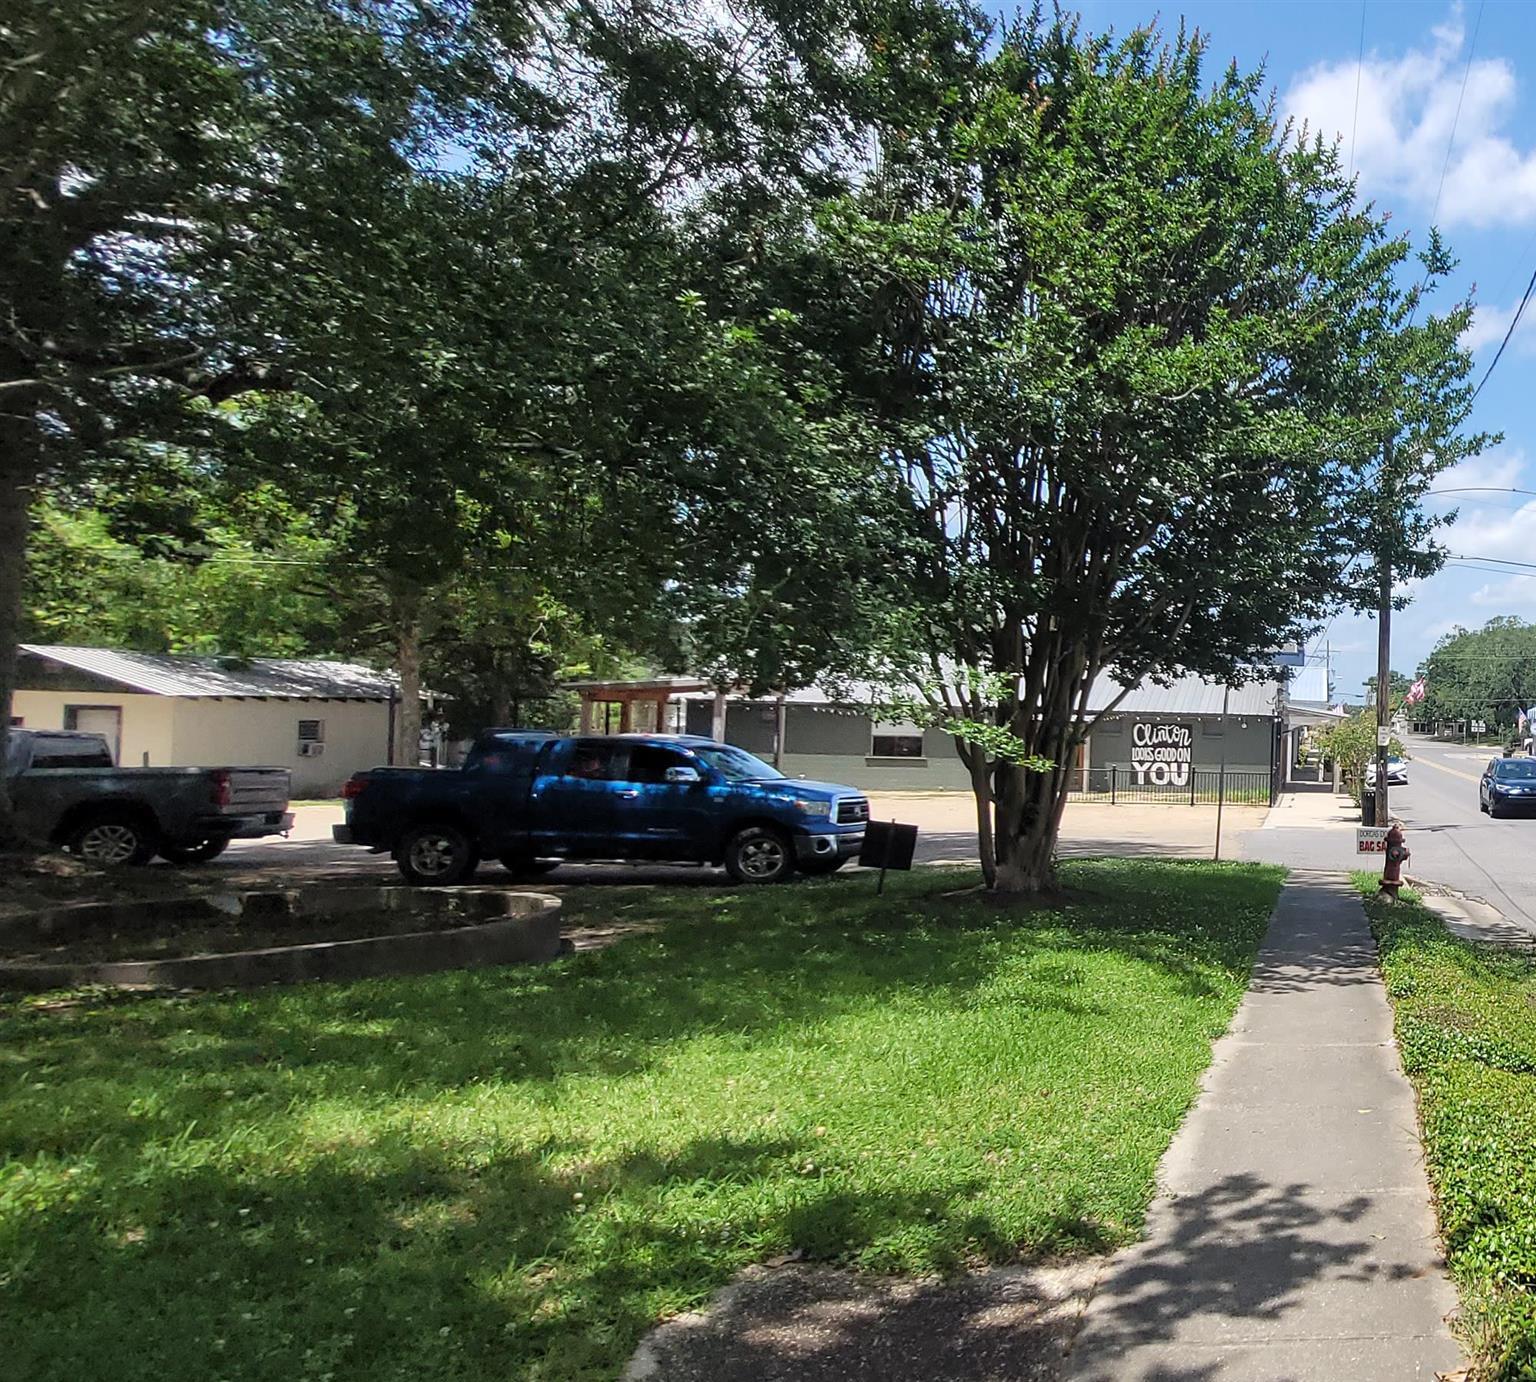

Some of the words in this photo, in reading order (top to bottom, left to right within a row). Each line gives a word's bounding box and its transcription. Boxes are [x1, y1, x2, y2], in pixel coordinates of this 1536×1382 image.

[1133, 723, 1192, 747] Clinton
[1131, 747, 1154, 761] LOOKS
[1154, 747, 1177, 762] GOOD
[1177, 747, 1191, 763] ON
[1131, 761, 1189, 786] YOU
[1359, 840, 1375, 852] BAG
[1376, 840, 1388, 852] SA
